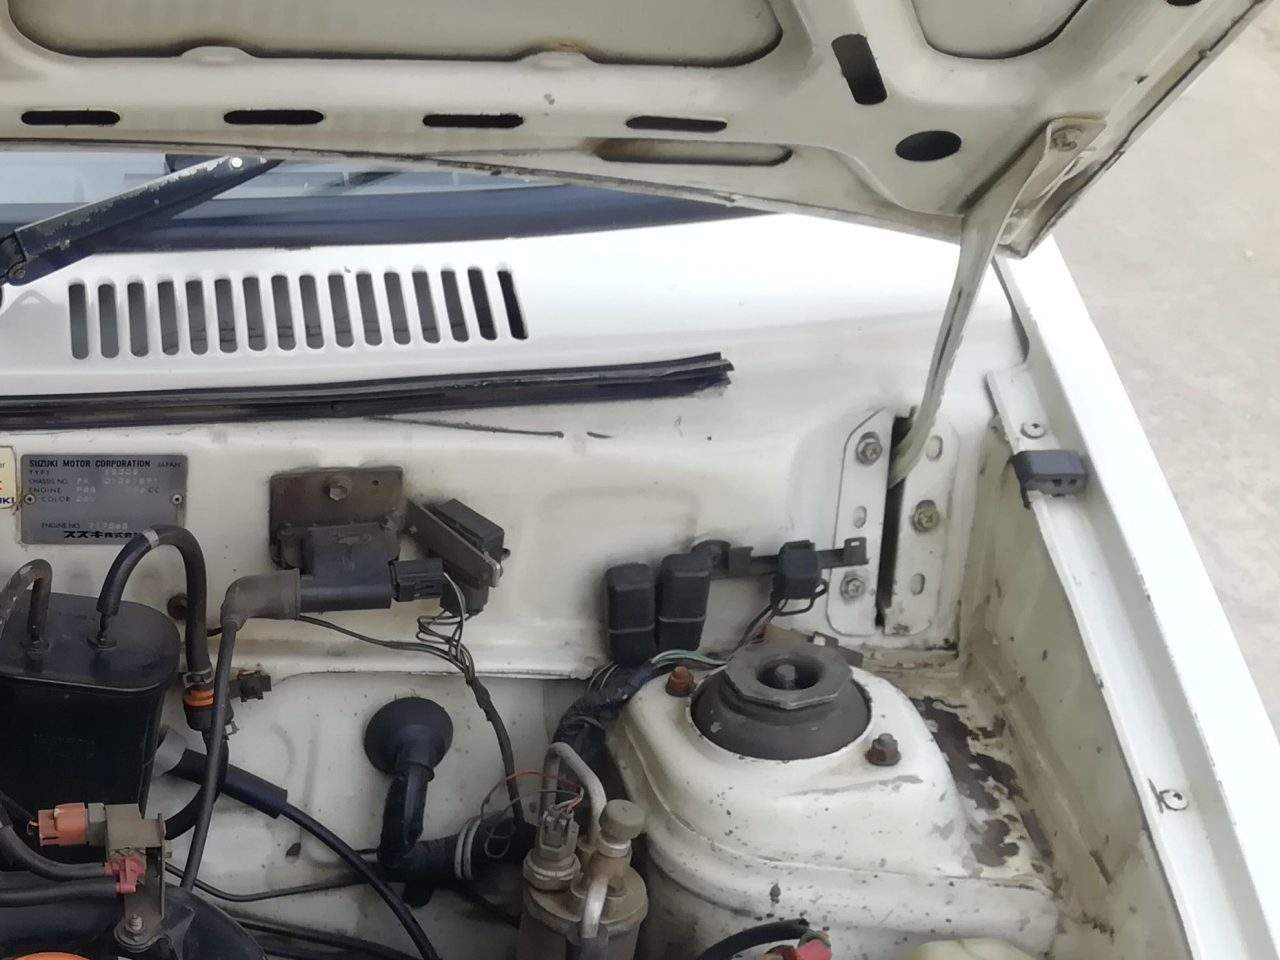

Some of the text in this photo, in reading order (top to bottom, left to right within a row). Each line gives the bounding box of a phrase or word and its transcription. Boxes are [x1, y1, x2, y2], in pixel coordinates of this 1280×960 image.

[29, 460, 58, 468] SUZUKI
[62, 460, 90, 468] MOTOR
[95, 460, 151, 468] CORPORATION
